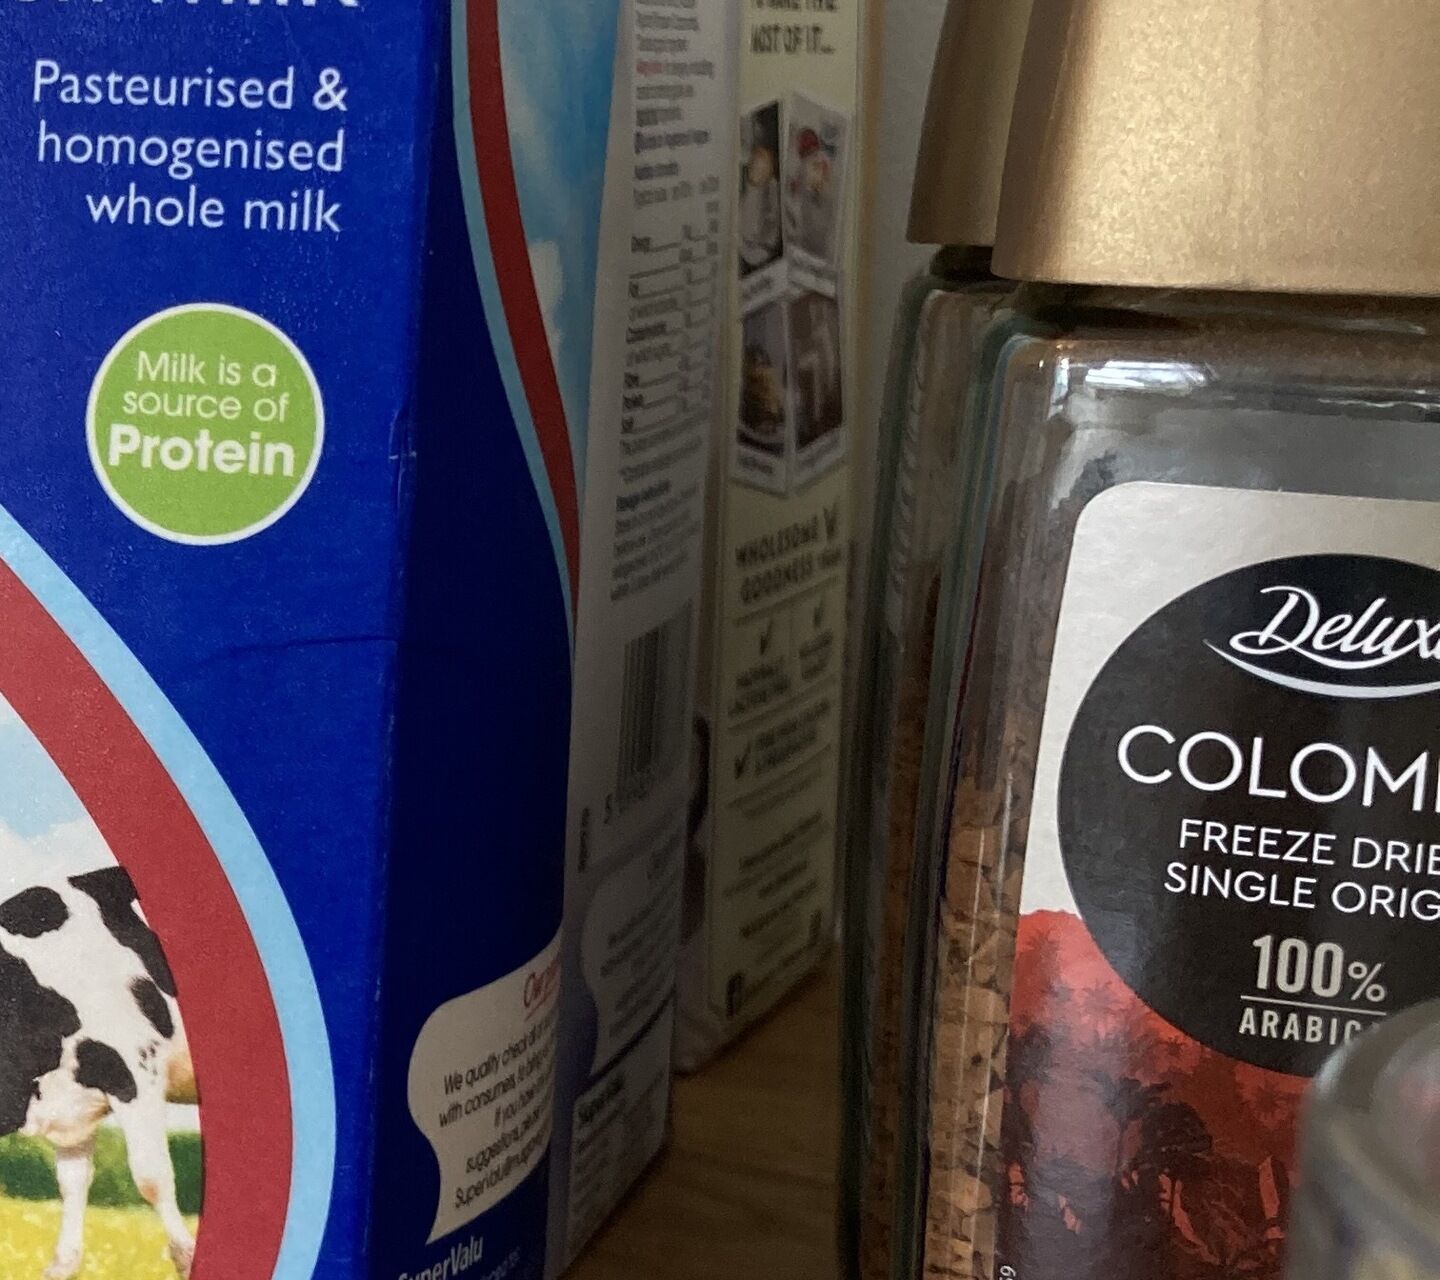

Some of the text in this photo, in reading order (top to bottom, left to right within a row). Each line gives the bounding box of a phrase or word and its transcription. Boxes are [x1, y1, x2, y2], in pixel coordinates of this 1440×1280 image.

[33, 59, 350, 113] Pasteurised &
[36, 119, 346, 180] homogenised
[85, 182, 342, 234] whole milk
[137, 349, 278, 388] Milk is a
[122, 390, 290, 424] source of
[108, 423, 295, 478] Protein
[1229, 584, 1440, 671] Delux
[1117, 723, 1440, 813] COLOM
[1177, 818, 1440, 876] FREEZE DRIE
[1163, 861, 1440, 921] SINGLE ORIG
[1252, 933, 1387, 1005] 100%
[1239, 1006, 1364, 1048] ARABIC
[443, 1072, 464, 1096] We
[464, 1049, 500, 1089] quality
[439, 1100, 463, 1129] with
